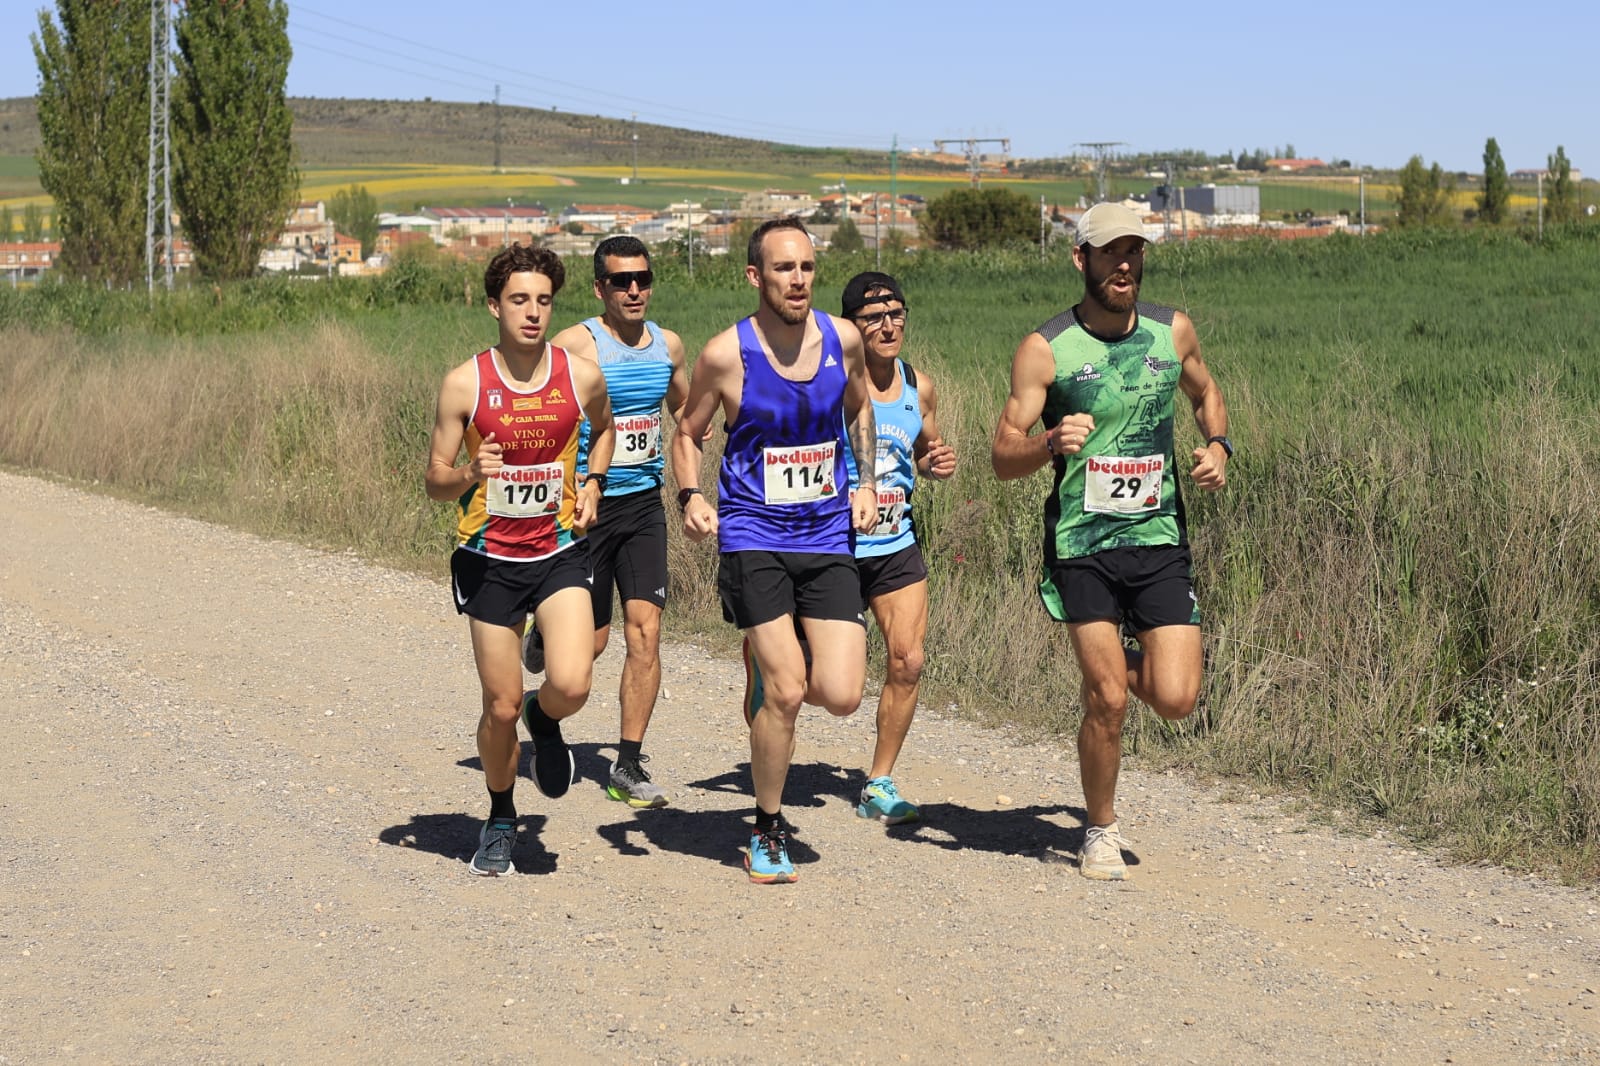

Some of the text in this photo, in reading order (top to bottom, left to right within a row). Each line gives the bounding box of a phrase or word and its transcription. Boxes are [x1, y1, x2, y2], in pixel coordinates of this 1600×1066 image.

[1076, 373, 1101, 382] VIATOR
[515, 414, 559, 423] CAJA RURAL
[616, 417, 659, 431] edunia
[513, 428, 546, 440] VINO
[625, 432, 647, 452] 38
[502, 439, 556, 450] DE TORO
[766, 447, 834, 465] bedunia
[1088, 458, 1162, 474] bedunia
[783, 464, 824, 488] 114
[504, 483, 548, 505] 170
[1110, 477, 1141, 498] 29
